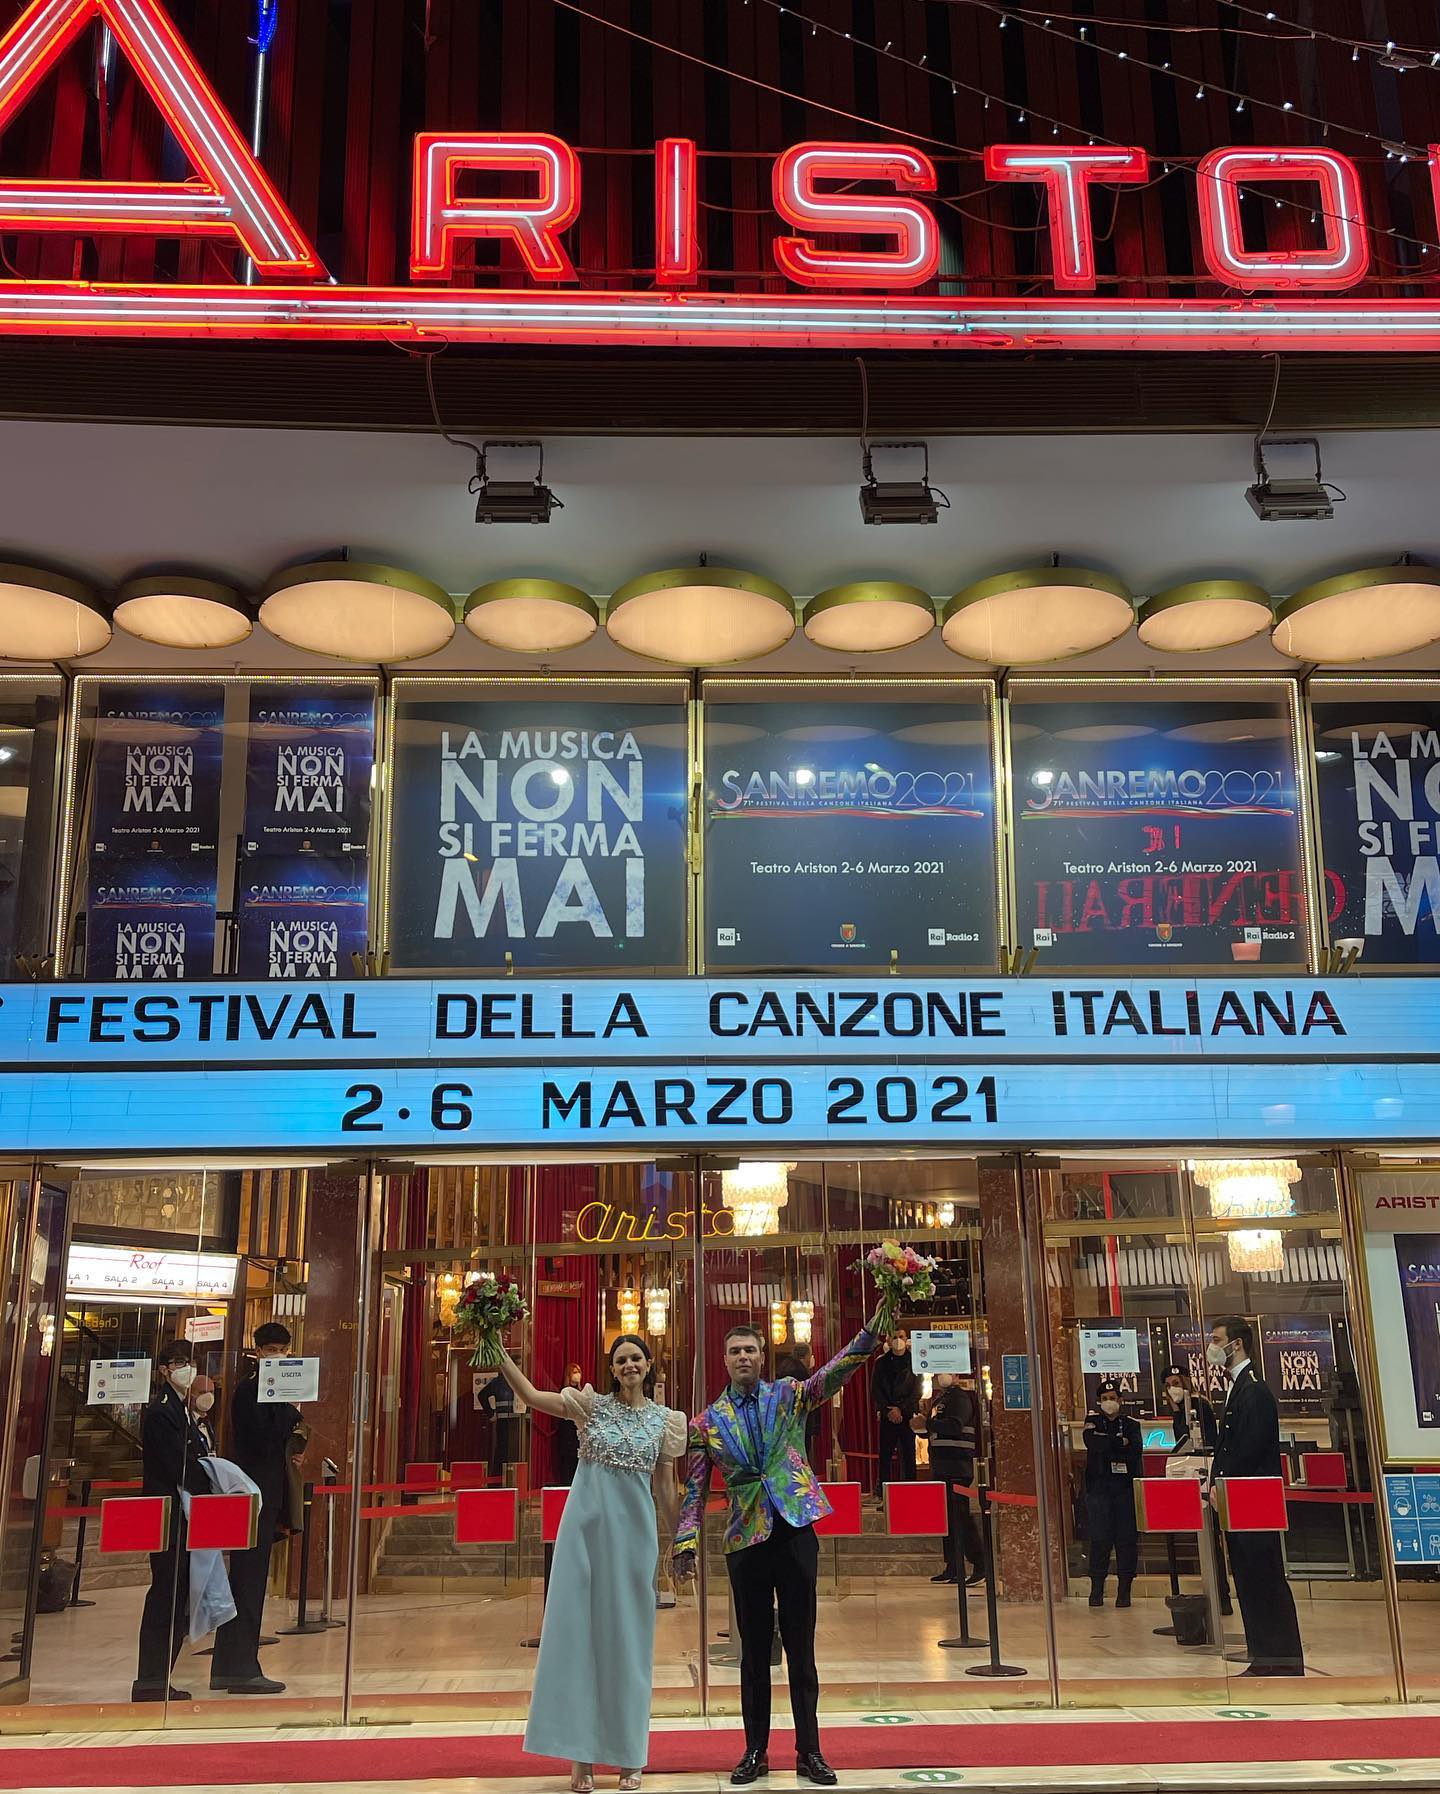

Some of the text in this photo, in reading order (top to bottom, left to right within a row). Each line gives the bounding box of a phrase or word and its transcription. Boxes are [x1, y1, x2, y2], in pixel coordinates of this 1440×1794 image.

[127, 745, 193, 756] LA MUSICA
[278, 745, 344, 756] LA MUSICA
[441, 731, 643, 760] LA MUSICA
[1351, 731, 1397, 759] LA
[126, 755, 194, 776] NON
[277, 756, 344, 776] NON
[125, 775, 192, 787] SI FERMA
[276, 775, 343, 787] SI FERMA
[440, 759, 644, 822] NON
[1353, 759, 1440, 821] N
[123, 786, 193, 812] MAI
[274, 786, 344, 812] MAI
[438, 822, 644, 857] SI FERMA
[1358, 822, 1394, 856] SI
[750, 861, 944, 874] Teatro Ariston 2-6 Marzo 2021
[1063, 860, 1257, 874] Teatro Ariston 2-6 Marzo 2021
[434, 857, 645, 938] MAI
[117, 922, 185, 933] LA MUSICA
[270, 921, 338, 931] LA MUSICA
[116, 932, 186, 953] NON
[269, 931, 338, 952] NON
[736, 932, 741, 942] 1
[946, 932, 972, 942] Radio
[973, 932, 979, 942] 2
[1262, 931, 1288, 941] Radio
[1289, 931, 1296, 941] 2
[115, 953, 184, 965] SI FERMA
[269, 952, 337, 963] SI FERMA
[46, 989, 1347, 1043] FESTIVAL DELLA CANZONE ITALIANA
[542, 1075, 793, 1129] MARZO
[827, 1075, 999, 1125] 2021
[129, 1253, 167, 1274] Roof
[104, 1275, 137, 1284] SALA 2
[152, 1278, 175, 1286] SALA
[1280, 1356, 1319, 1369] NON
[1281, 1368, 1289, 1376] SI
[1282, 1375, 1322, 1391] MAI
